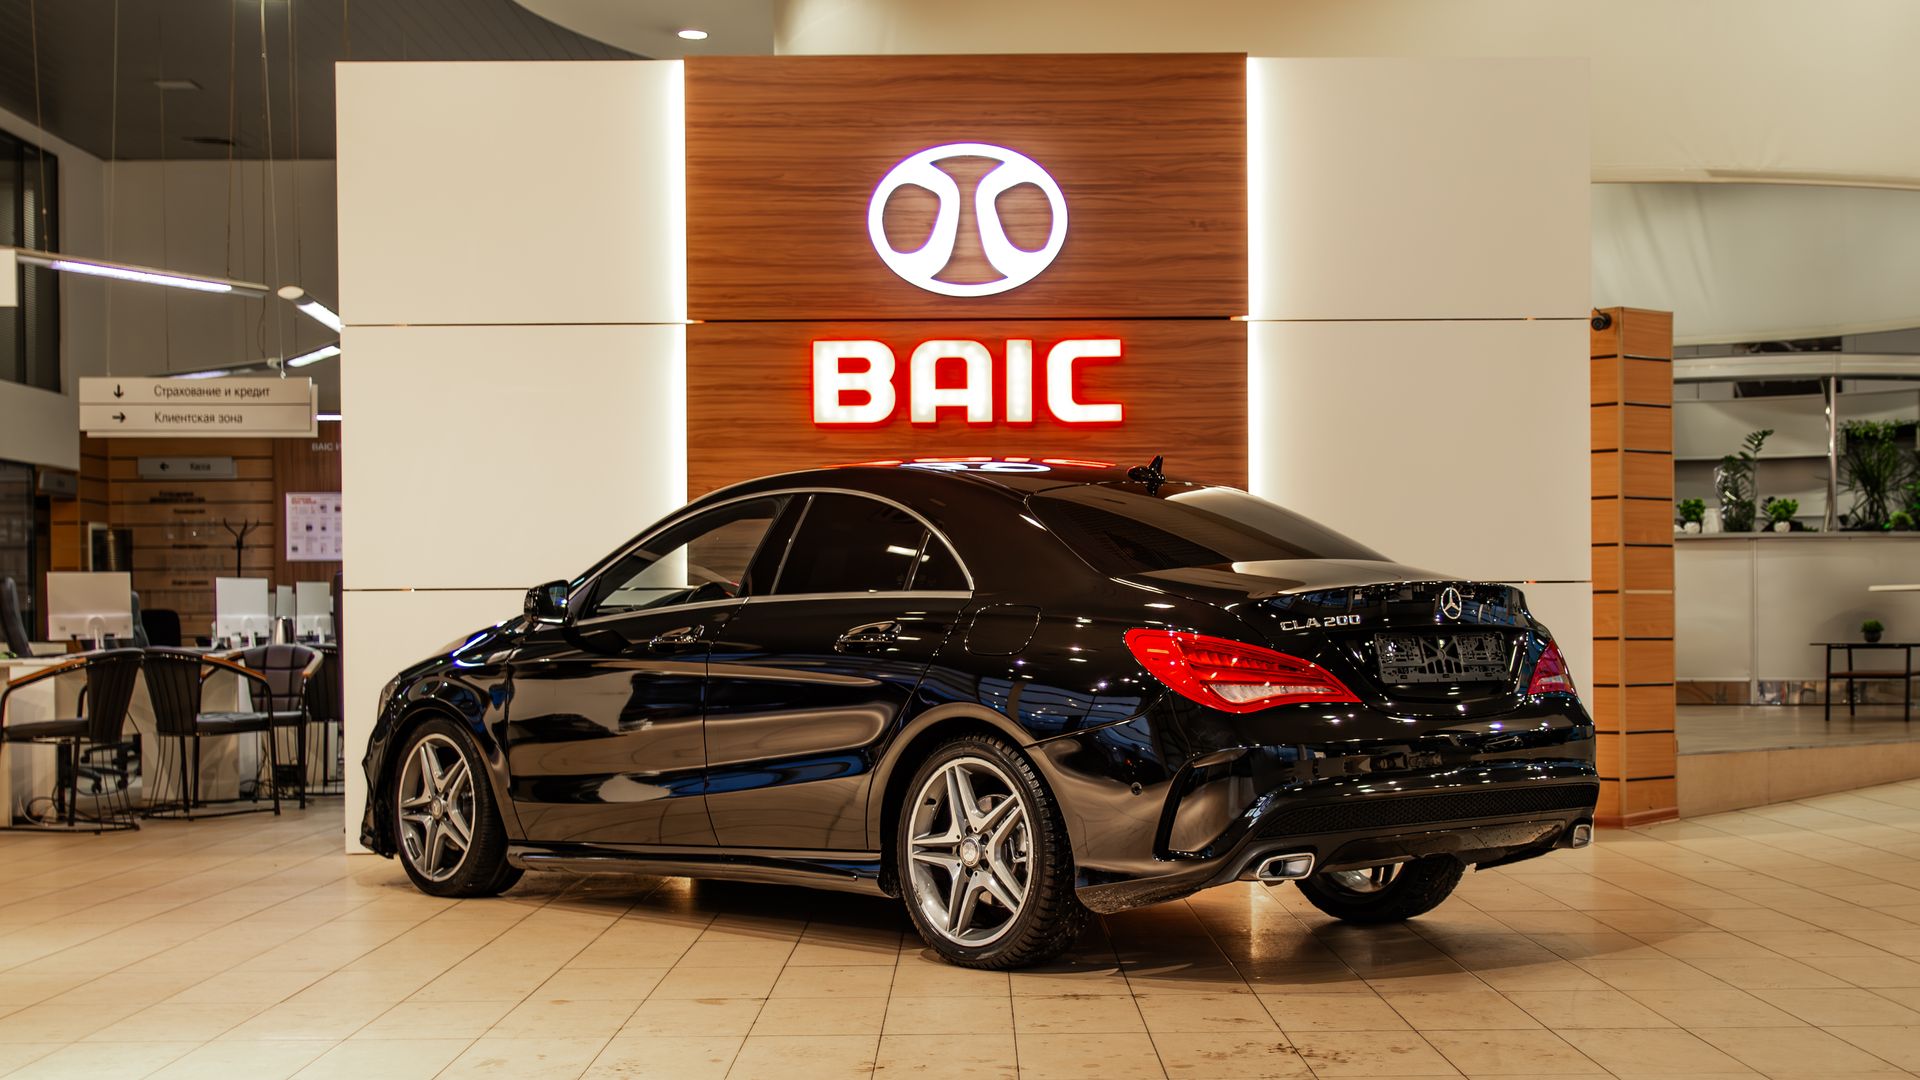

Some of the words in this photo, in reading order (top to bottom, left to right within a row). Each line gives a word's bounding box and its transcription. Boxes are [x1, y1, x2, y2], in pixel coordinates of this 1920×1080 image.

[812, 339, 1123, 424] BAIC
[153, 384, 221, 399] Страхование
[224, 387, 231, 397] и
[234, 387, 270, 400] кредит
[154, 411, 216, 423] Клиентская
[218, 413, 243, 423] зона
[1280, 617, 1321, 631] CLA
[1323, 614, 1361, 627] 200
